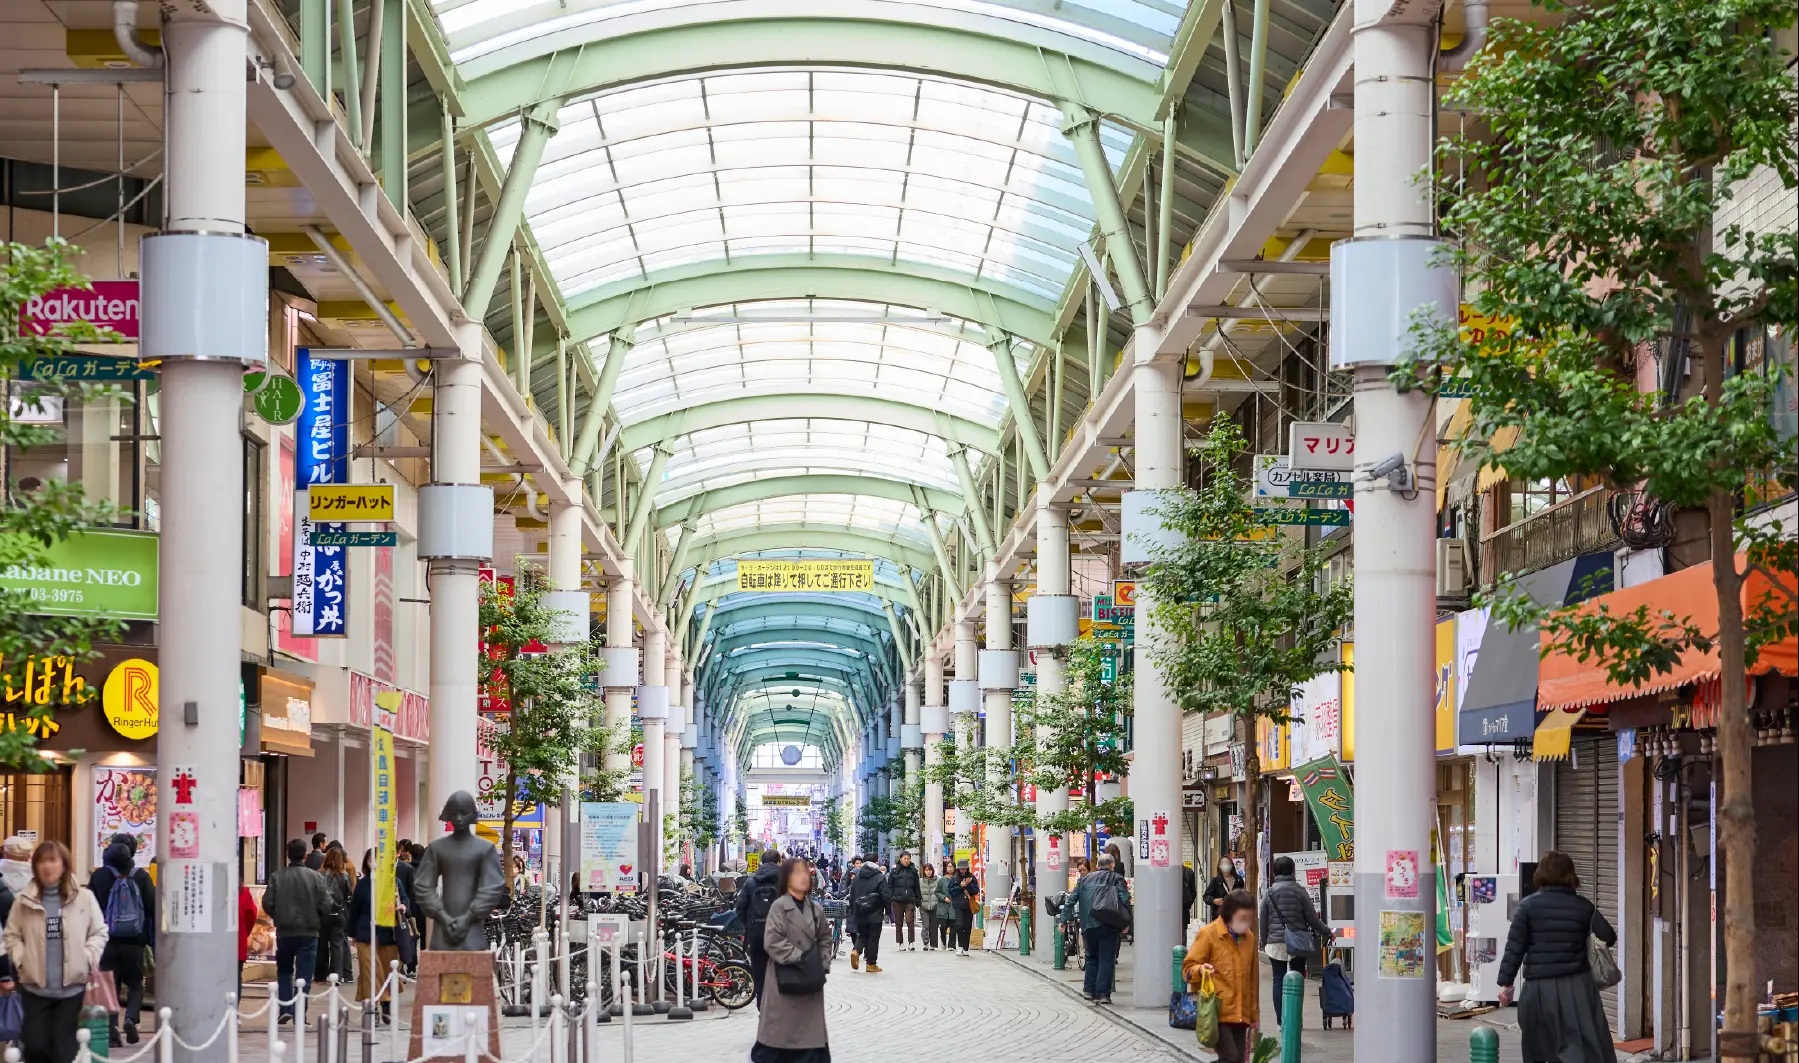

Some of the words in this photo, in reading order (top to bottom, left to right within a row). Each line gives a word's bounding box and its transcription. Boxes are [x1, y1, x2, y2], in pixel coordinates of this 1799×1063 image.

[27, 294, 139, 321] Rakuten
[31, 361, 78, 377] LaLa
[271, 379, 284, 421] HAIR
[1298, 483, 1334, 495] LaLa
[311, 495, 391, 510] リンガーハット
[317, 533, 348, 545] LaLa
[350, 533, 391, 544] ガーデン
[85, 568, 141, 587] NEO
[741, 572, 871, 589] 自転車は降りて押してご通行下さい
